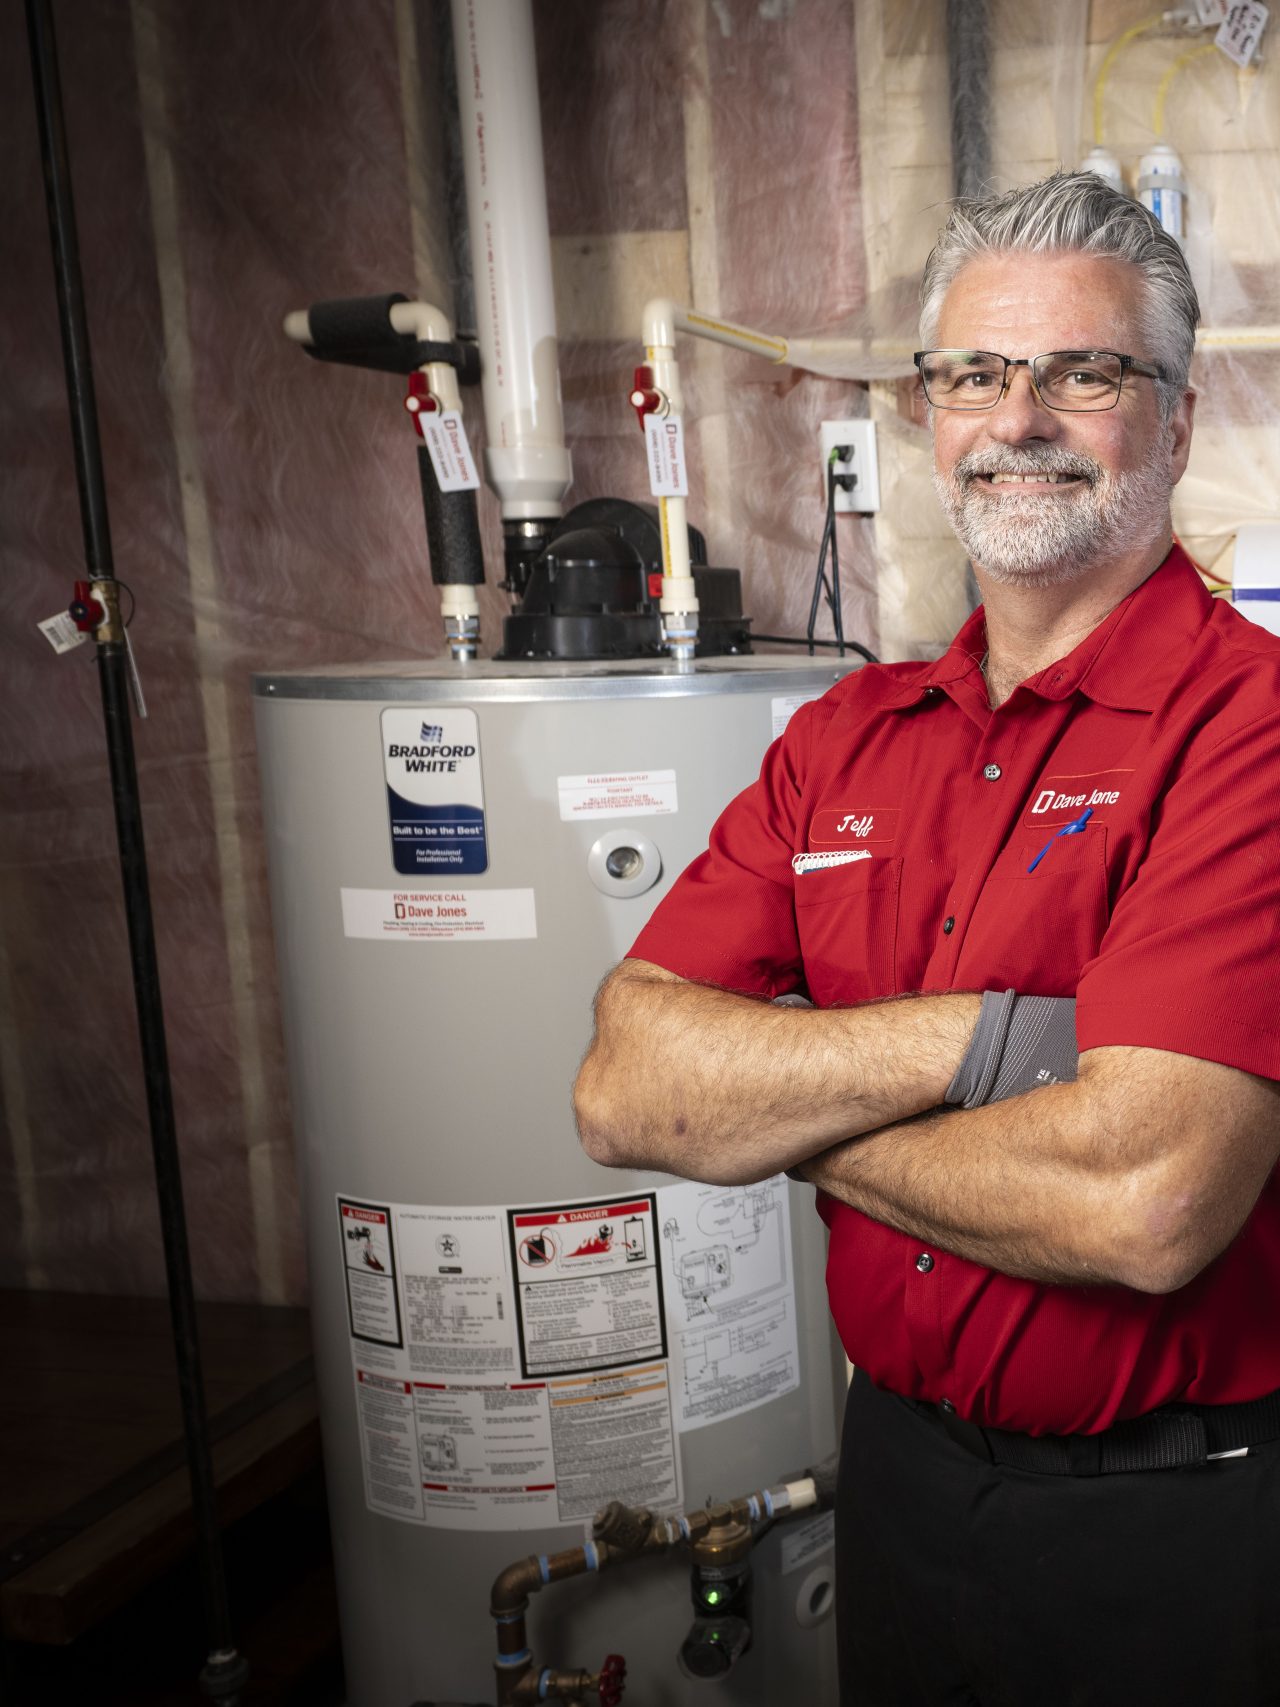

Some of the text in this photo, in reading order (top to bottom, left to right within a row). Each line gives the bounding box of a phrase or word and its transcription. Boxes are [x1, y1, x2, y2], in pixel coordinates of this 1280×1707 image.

[388, 744, 476, 758] BRADFORD
[405, 760, 457, 773] WHITE
[1052, 794, 1086, 810] Dave
[392, 826, 480, 835] Built to be the Best
[837, 815, 874, 837] Jeff
[449, 856, 464, 864] Only
[408, 905, 433, 917] Dave
[436, 905, 467, 917] Jones
[355, 1210, 380, 1221] DANGER
[570, 1210, 608, 1222] DANGER
